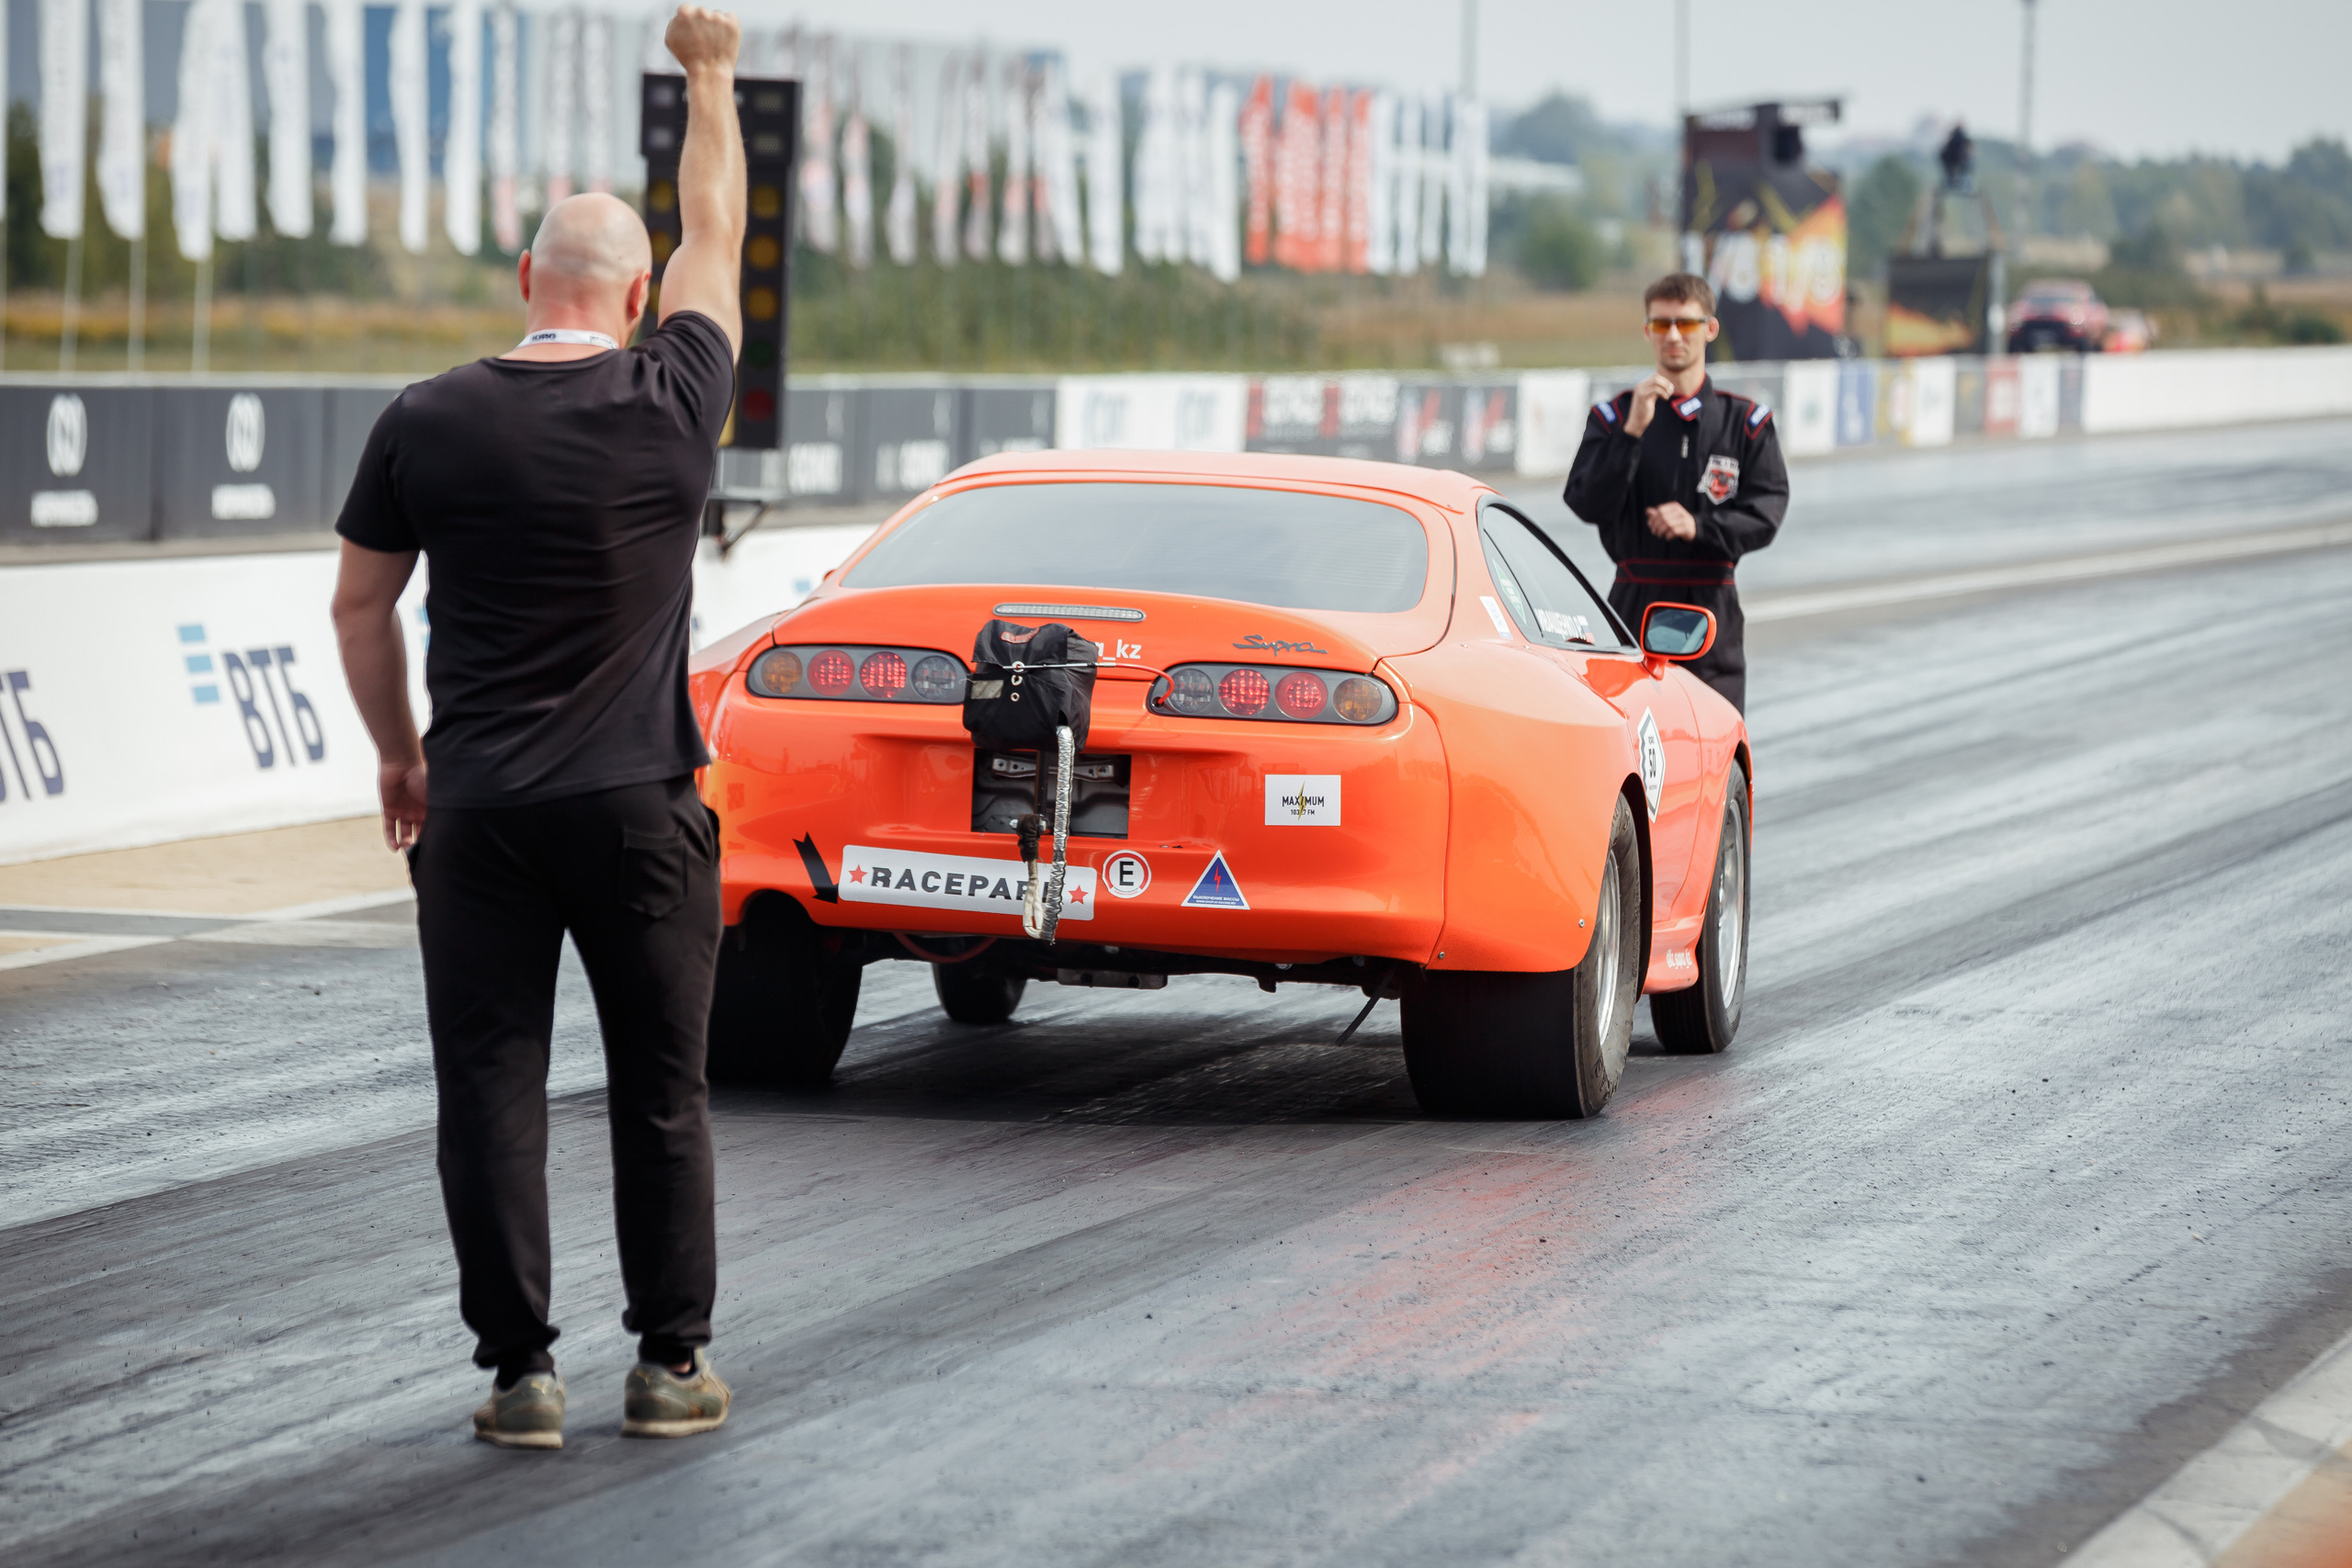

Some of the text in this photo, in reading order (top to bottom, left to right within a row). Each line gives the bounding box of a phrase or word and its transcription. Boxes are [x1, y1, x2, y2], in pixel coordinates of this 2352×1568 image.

[1232, 634, 1329, 658] Supra
[222, 646, 325, 769] ВТБ
[1282, 795, 1325, 807] MAXIMUM
[1119, 861, 1135, 886] E
